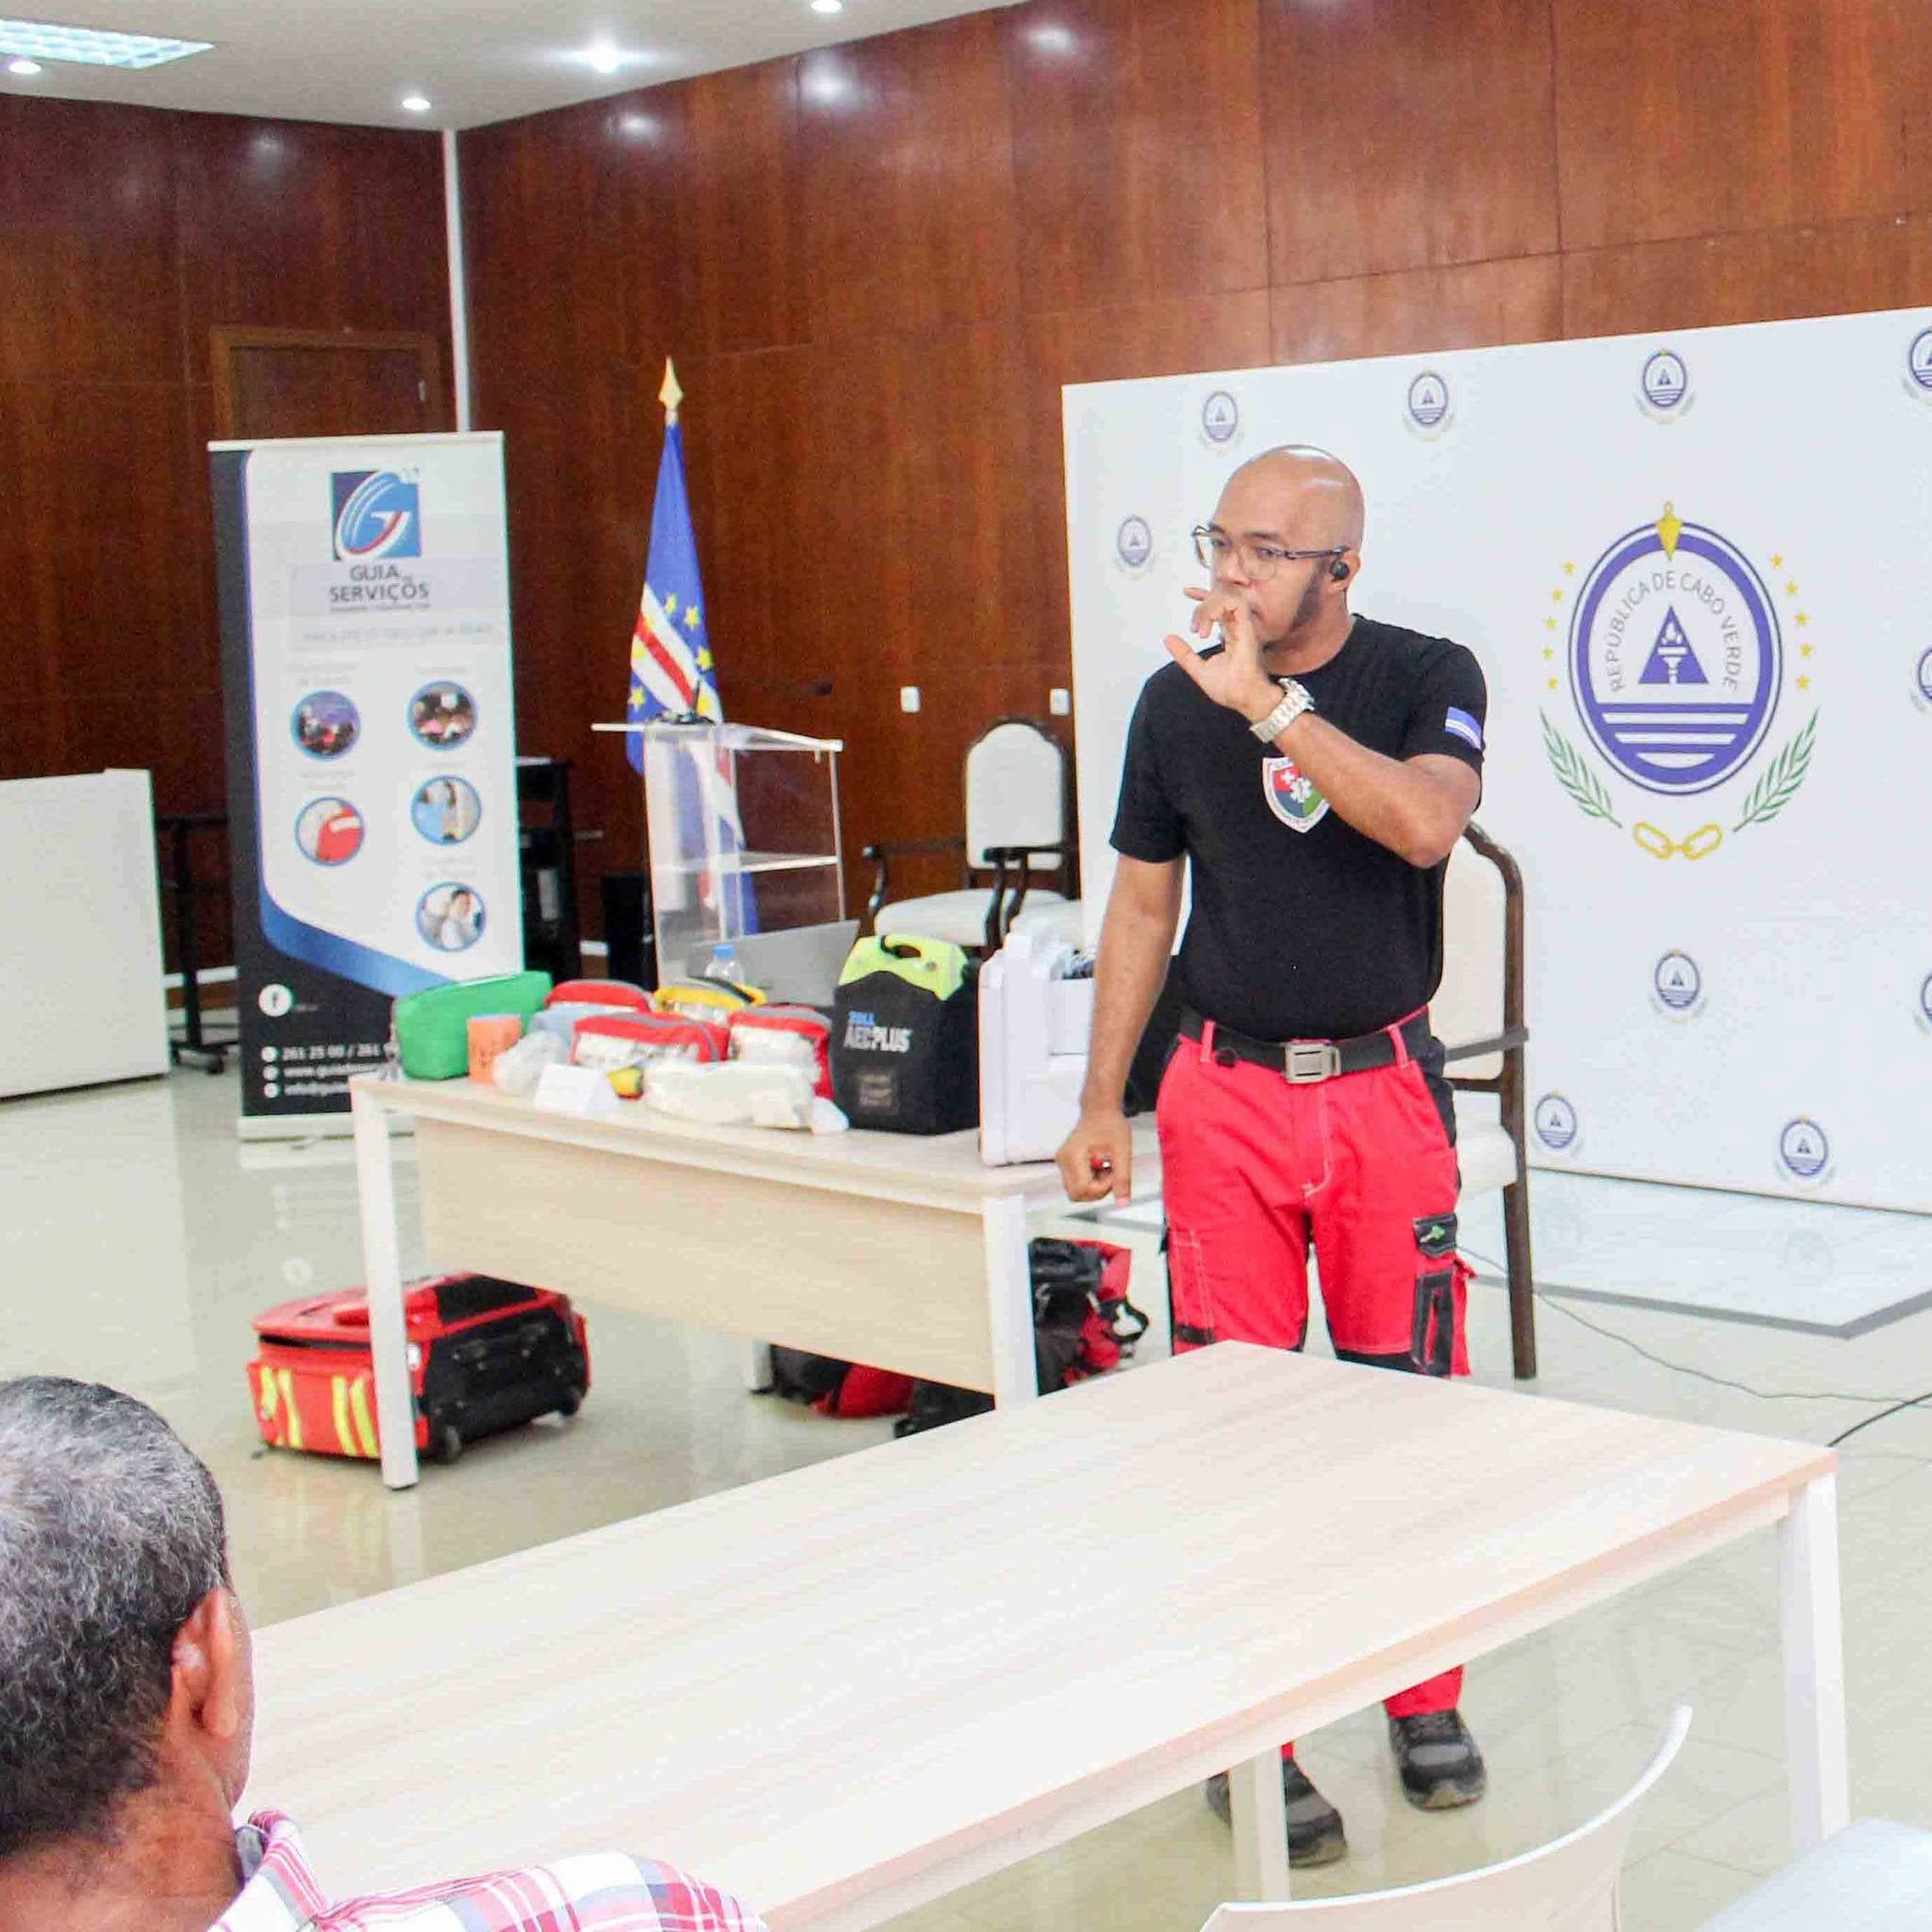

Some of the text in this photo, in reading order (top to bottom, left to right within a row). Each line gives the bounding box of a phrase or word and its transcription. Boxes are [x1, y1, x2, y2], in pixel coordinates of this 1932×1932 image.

[349, 564, 400, 581] GUIA
[329, 581, 429, 603] SERVIÇOS
[1652, 569, 1676, 591] DE
[1679, 572, 1725, 615] CABO
[1720, 614, 1742, 691] VERDE
